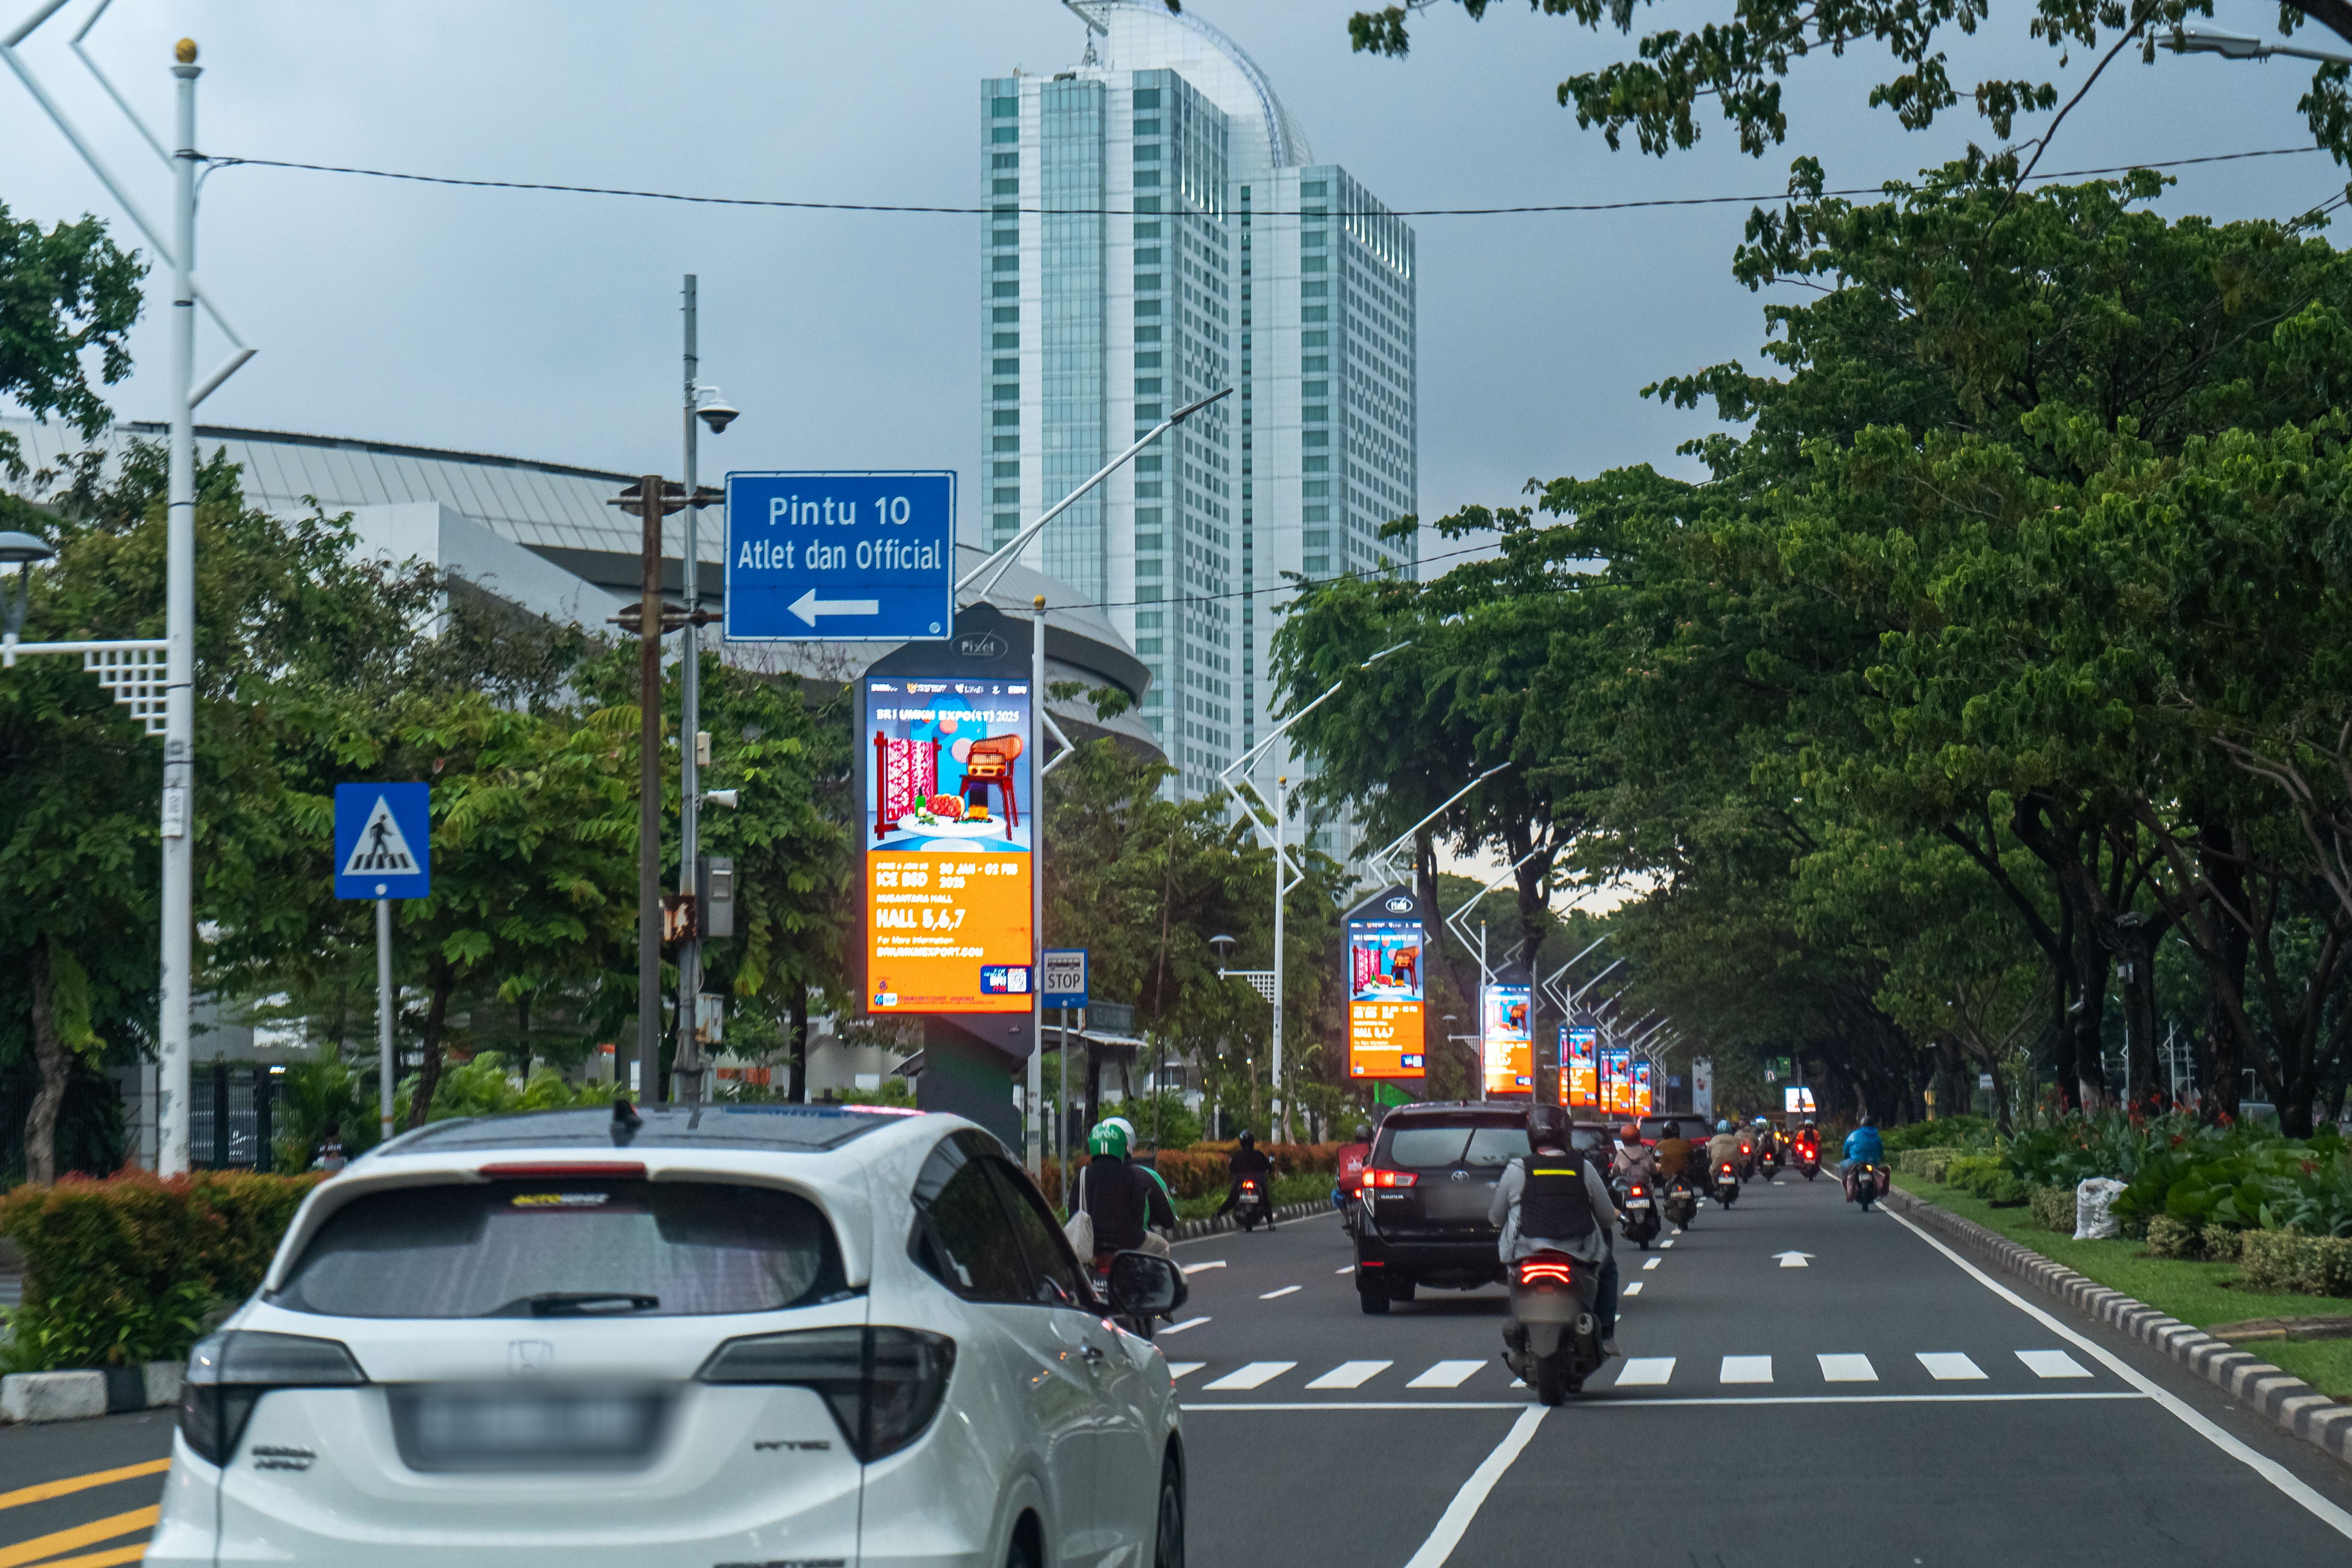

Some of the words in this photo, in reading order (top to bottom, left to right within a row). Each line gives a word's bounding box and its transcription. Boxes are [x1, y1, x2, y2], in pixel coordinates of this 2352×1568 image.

[770, 495, 856, 525] Pintu
[874, 496, 911, 525] 10
[738, 539, 795, 569] Atlet
[806, 539, 846, 570] dan
[856, 539, 941, 569] Official
[876, 709, 897, 720] BRI
[996, 711, 1019, 722] 2025
[956, 863, 975, 875] JAN
[985, 863, 999, 875] 02
[1001, 863, 1018, 875] FEB
[876, 872, 898, 887] ICE
[902, 872, 928, 887] BSD
[939, 876, 965, 889] 2025
[876, 894, 929, 903] NUSANTARA
[931, 894, 953, 904] HALL
[876, 909, 918, 928] HALL
[922, 909, 966, 931] 5,6,7
[877, 935, 890, 944] For
[892, 935, 910, 944] More
[1048, 973, 1080, 988] STOP
